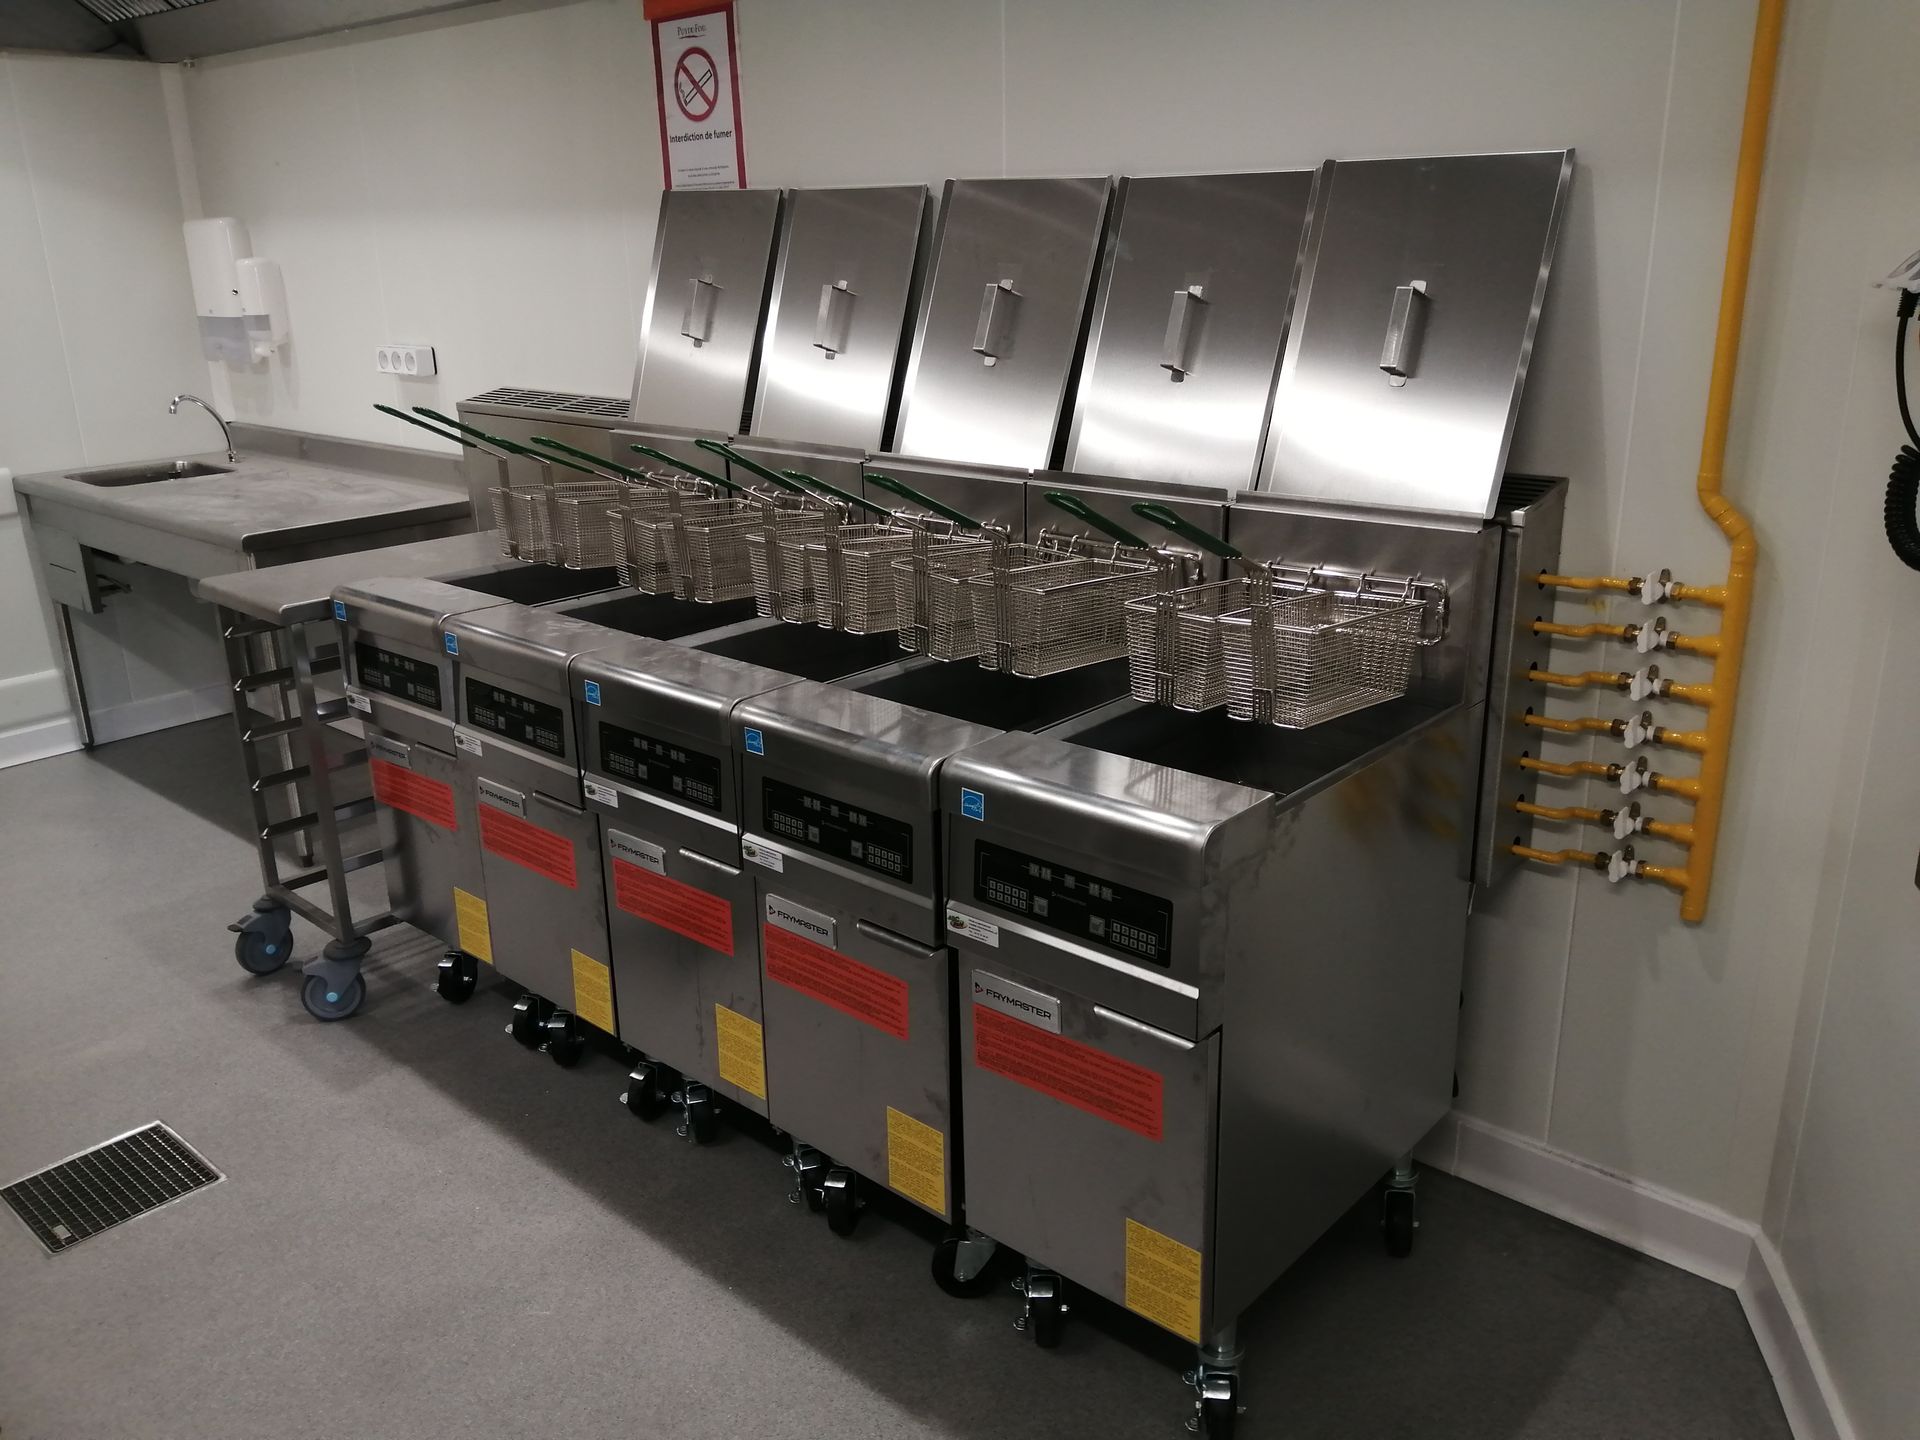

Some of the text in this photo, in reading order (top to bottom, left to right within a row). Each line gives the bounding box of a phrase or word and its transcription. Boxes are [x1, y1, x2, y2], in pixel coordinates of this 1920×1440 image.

[670, 130, 732, 143] Interdiction de fumer
[777, 910, 829, 936] FRYMASTER
[986, 988, 1052, 1020] FRYMASTER
